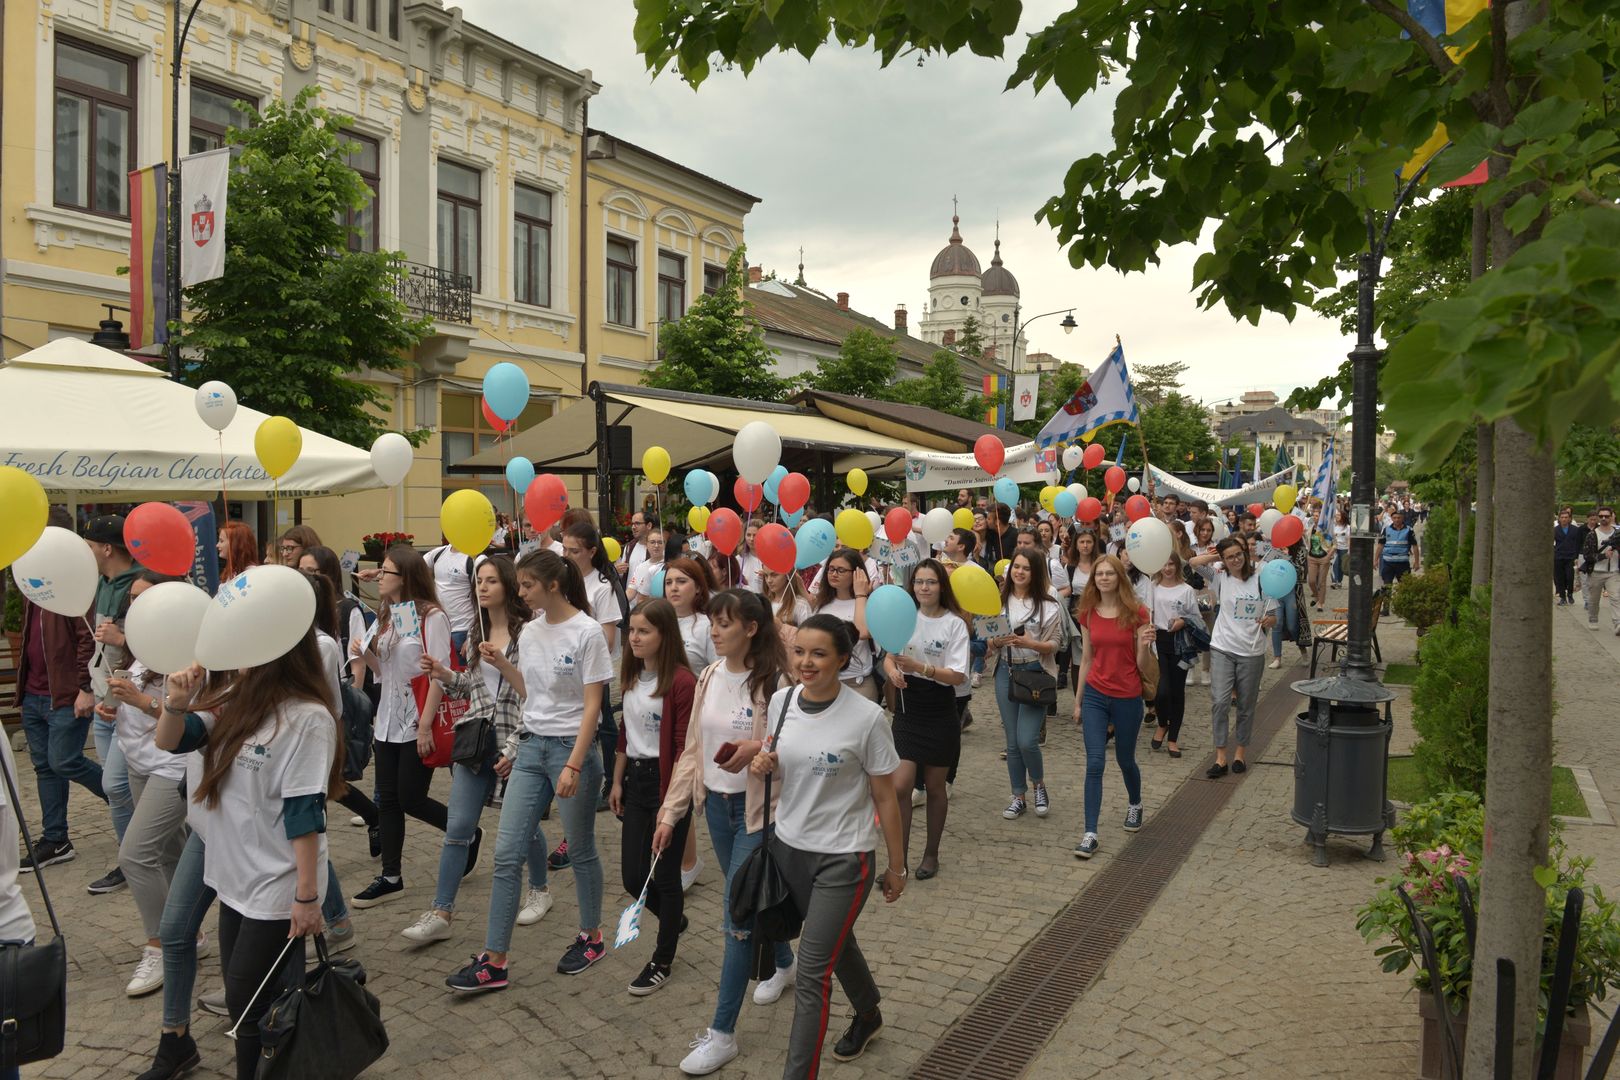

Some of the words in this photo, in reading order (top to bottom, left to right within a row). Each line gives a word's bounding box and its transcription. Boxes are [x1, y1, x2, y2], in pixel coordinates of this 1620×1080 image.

[4, 451, 68, 476] Fresh
[72, 452, 162, 487] Belgian
[168, 455, 272, 480] Chocolates
